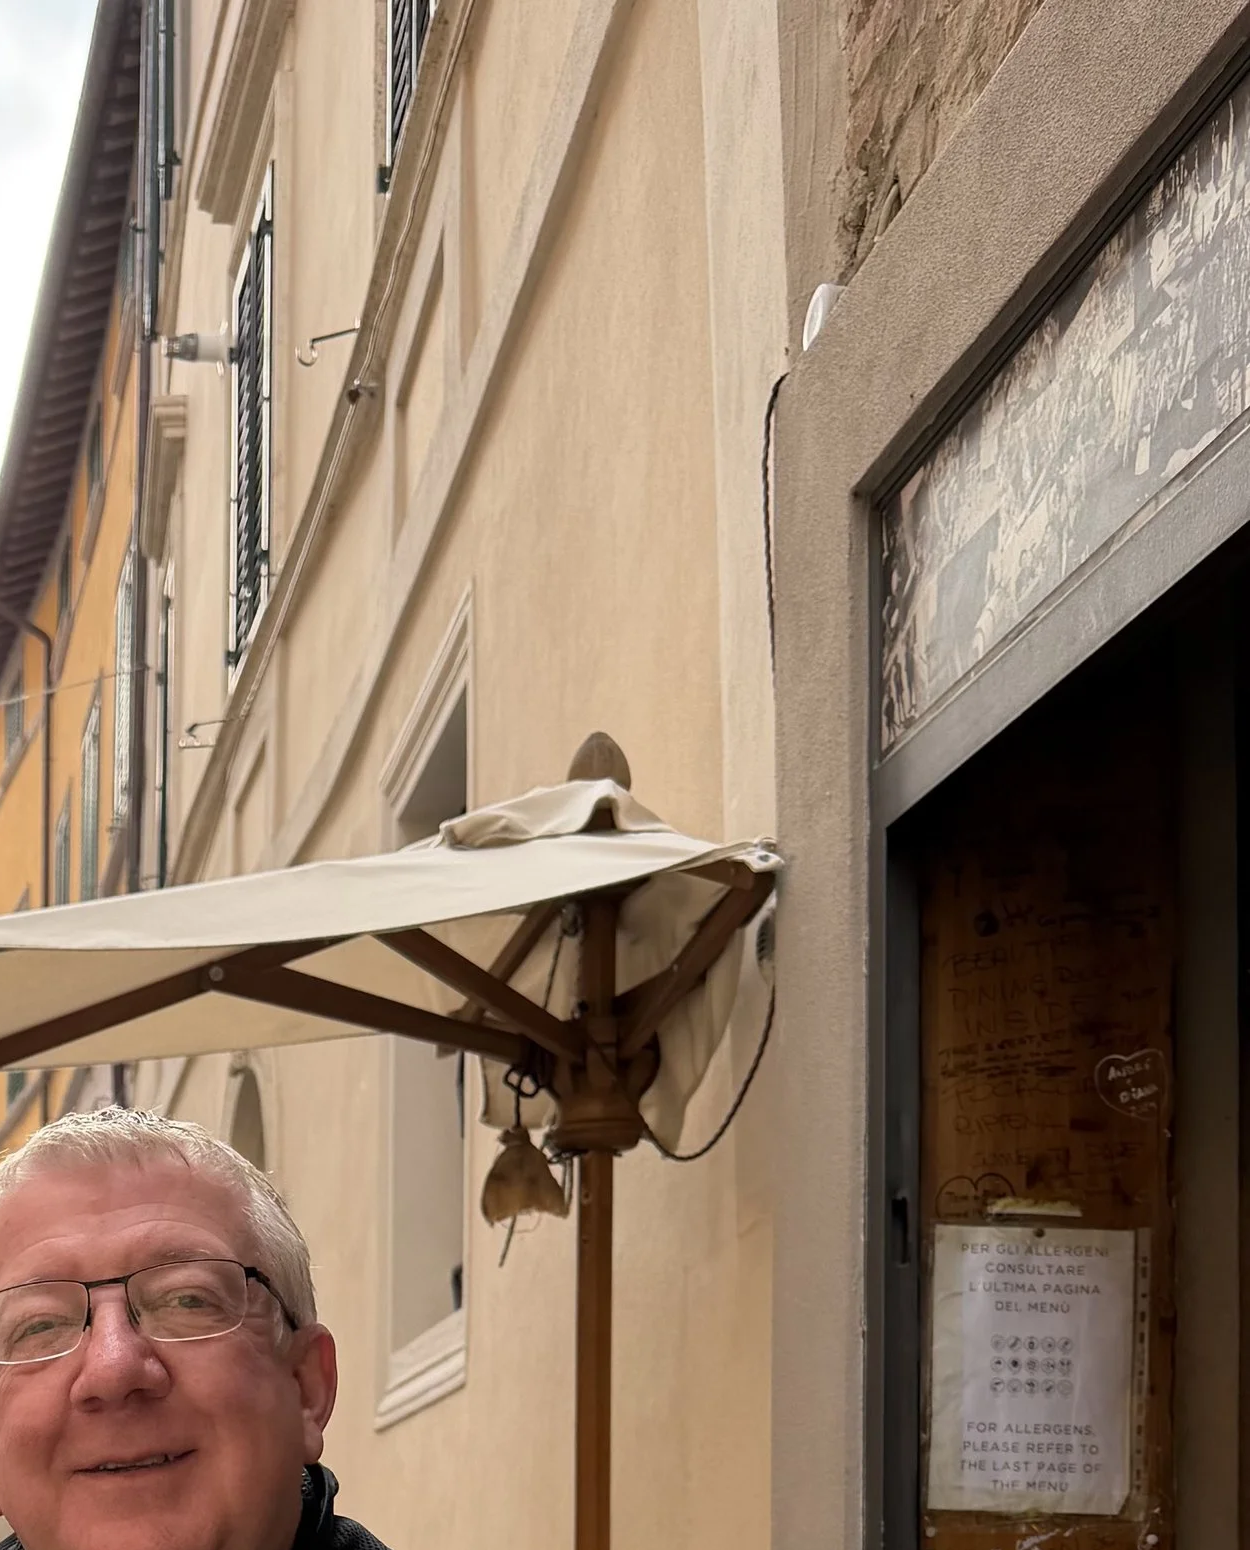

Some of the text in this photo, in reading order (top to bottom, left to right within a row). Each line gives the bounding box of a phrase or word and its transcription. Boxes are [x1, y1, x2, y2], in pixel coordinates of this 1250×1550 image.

[960, 1243, 1109, 1258] PER GLI ALLERGENI
[985, 1262, 1085, 1276] CONSULTARE
[969, 1281, 1101, 1296] L'ULTIMA PAGINA
[994, 1301, 1022, 1313] DEL
[966, 1422, 997, 1434] FOR
[962, 1441, 1100, 1456] PLEASE REFER TO
[960, 1460, 1102, 1475] THE LAST PAGE OF
[991, 1479, 1069, 1493] THE MENU
